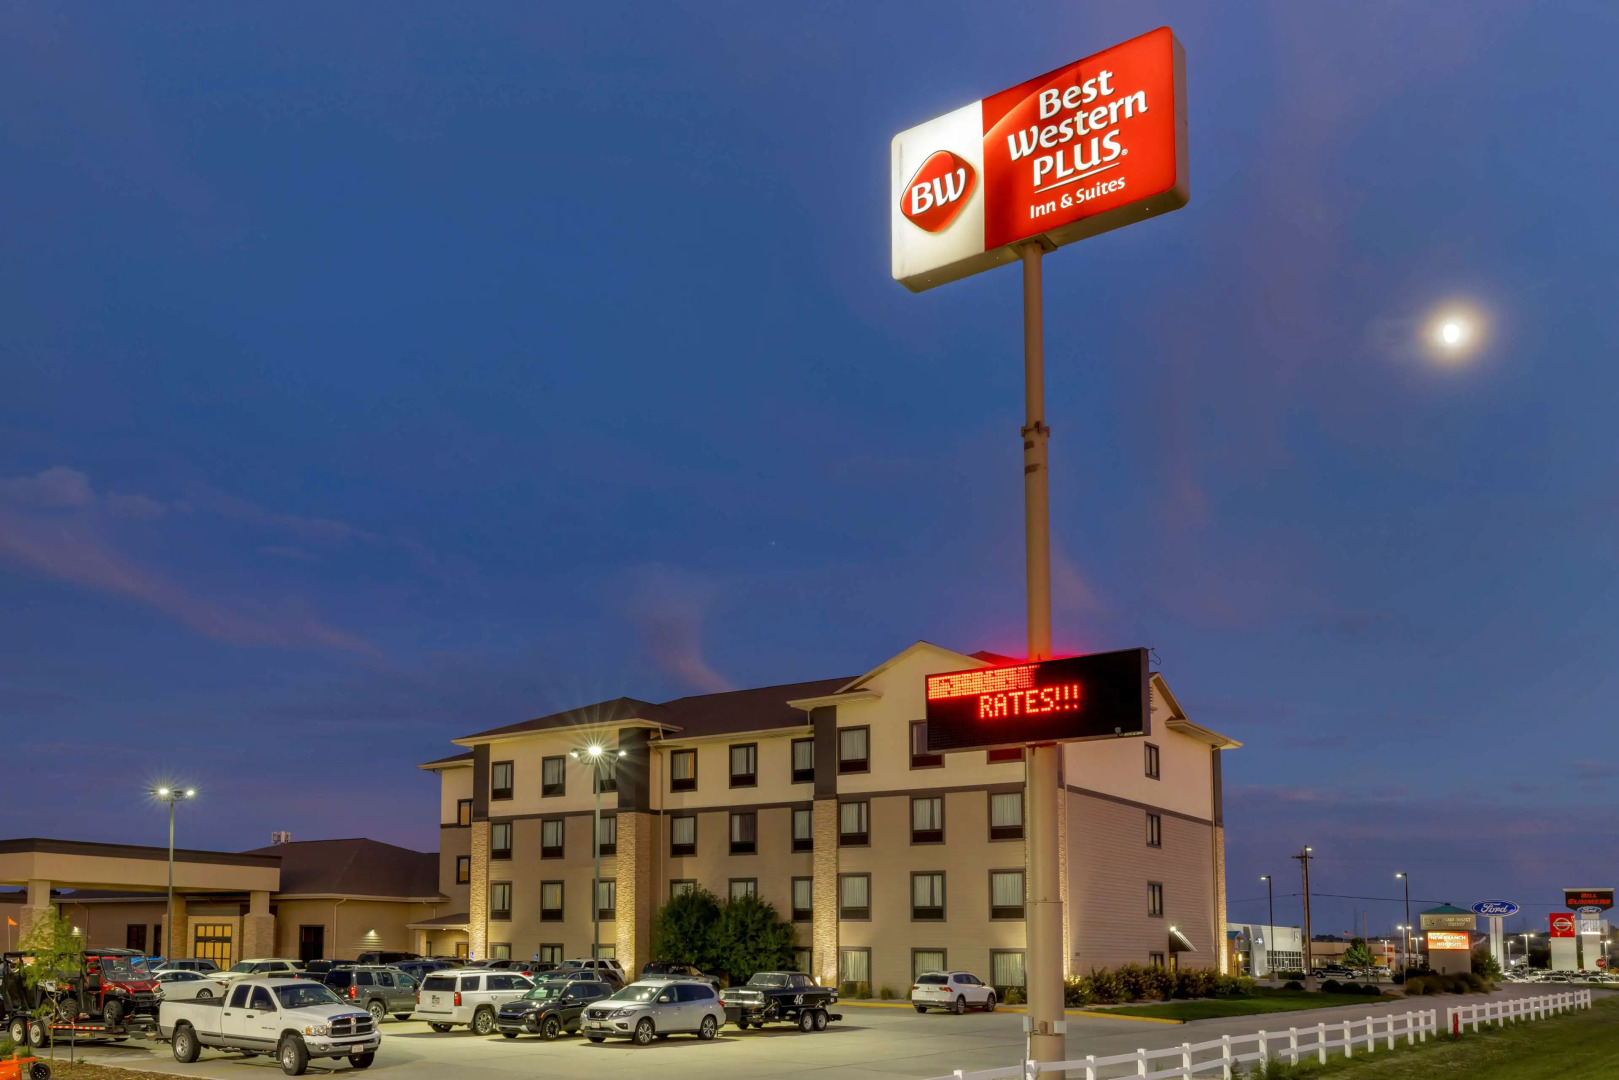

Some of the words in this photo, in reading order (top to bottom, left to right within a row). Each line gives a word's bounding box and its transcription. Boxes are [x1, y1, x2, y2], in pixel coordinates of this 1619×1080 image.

[1039, 70, 1114, 120] Best
[1007, 90, 1148, 161] Western
[910, 167, 967, 215] BW
[1030, 202, 1057, 219] Inn
[1060, 193, 1073, 209] &
[1076, 176, 1126, 204] Suites
[979, 684, 1079, 719] RATES!!!
[1480, 902, 1508, 913] Ford
[793, 994, 804, 1005] 46
